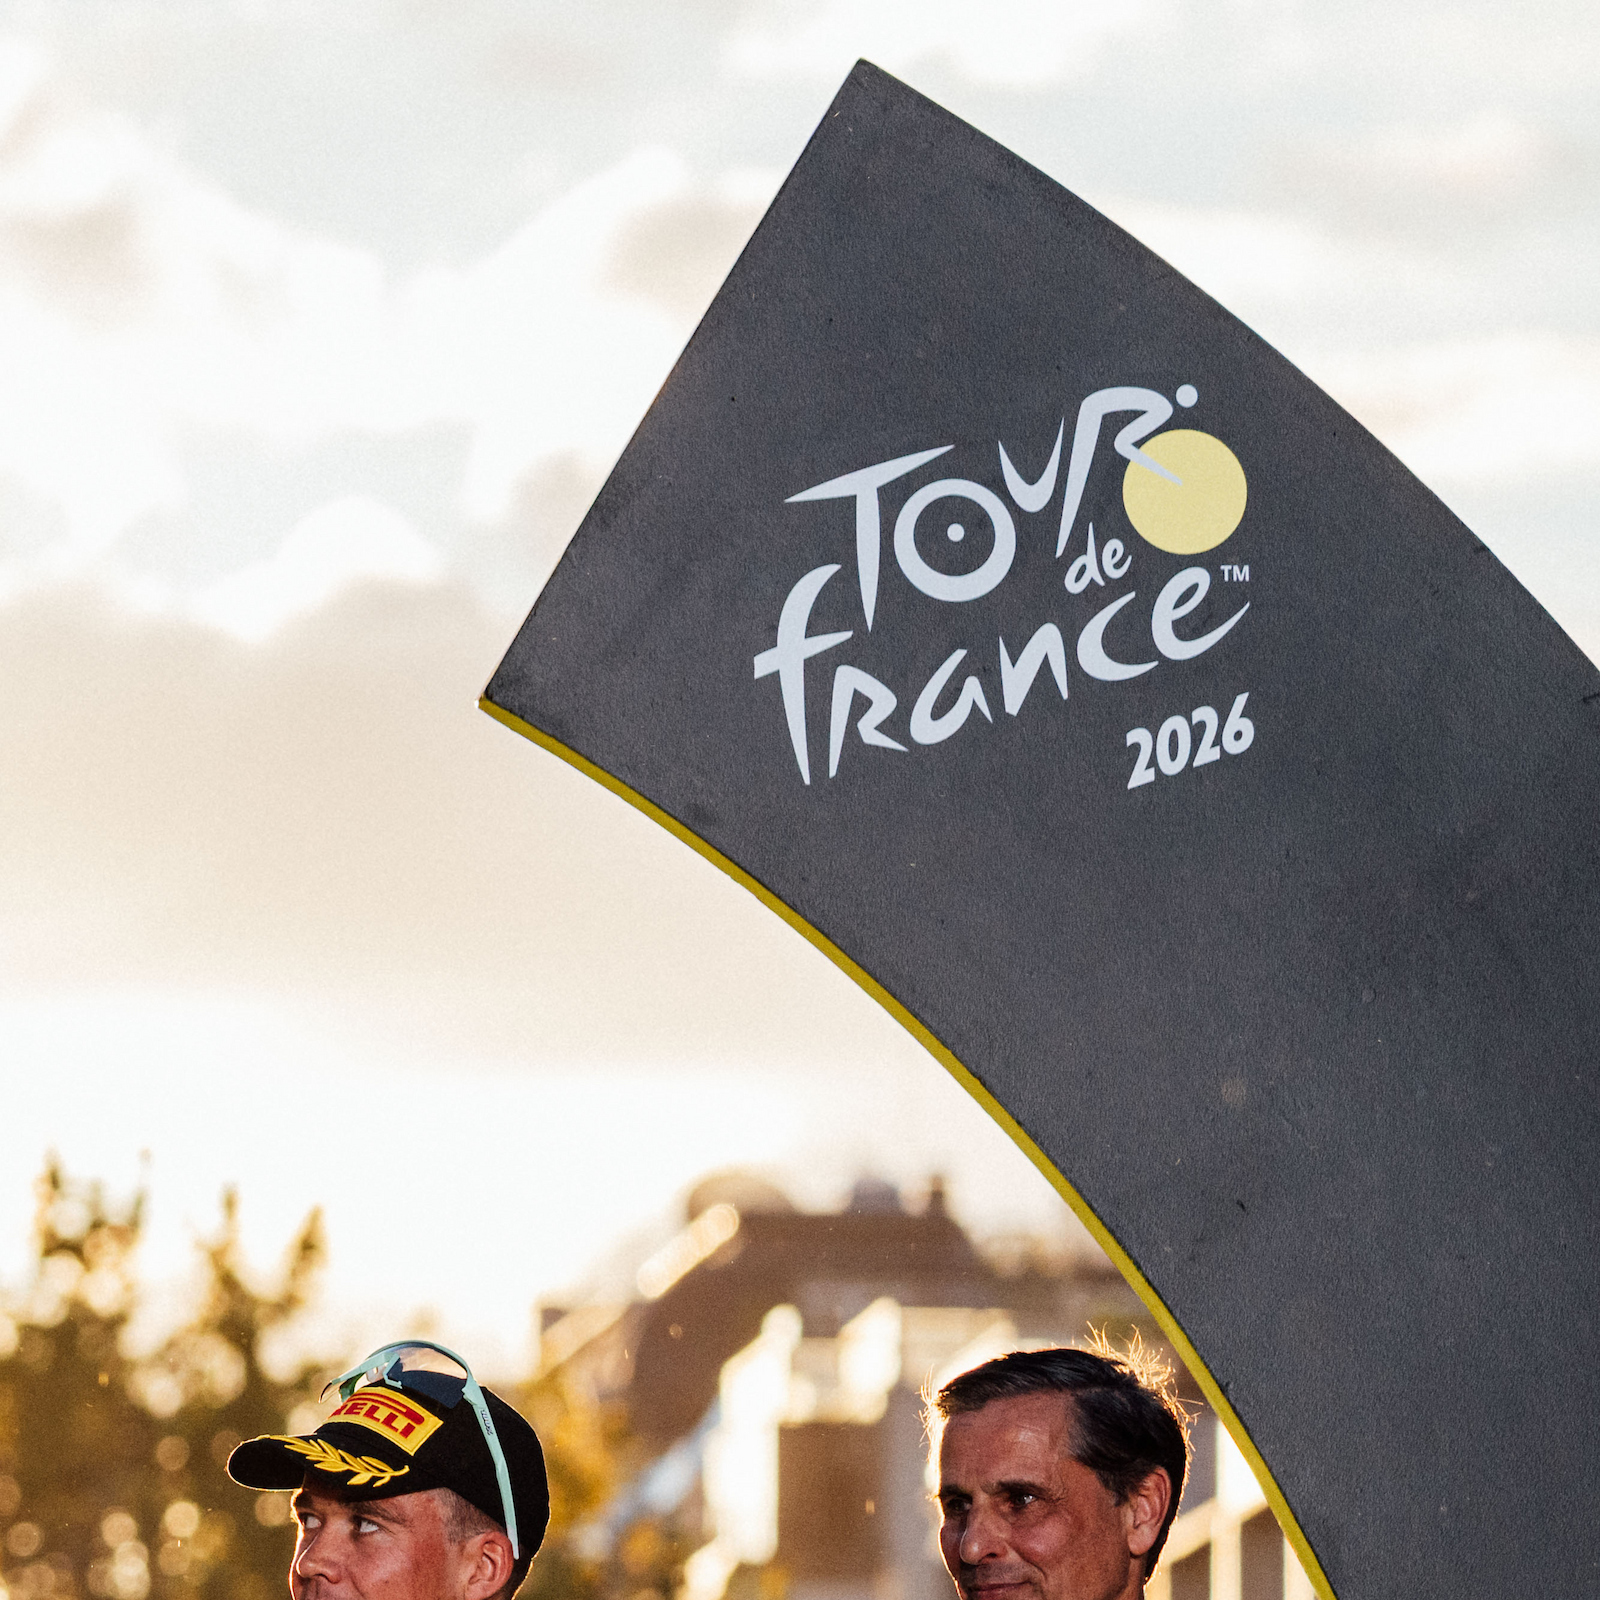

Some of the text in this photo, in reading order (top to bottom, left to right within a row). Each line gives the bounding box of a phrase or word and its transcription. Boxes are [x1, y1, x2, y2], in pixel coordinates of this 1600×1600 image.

[784, 384, 1198, 632] TOUR
[1064, 522, 1132, 594] de
[754, 565, 1250, 786] france TM
[1126, 692, 1255, 790] 2026
